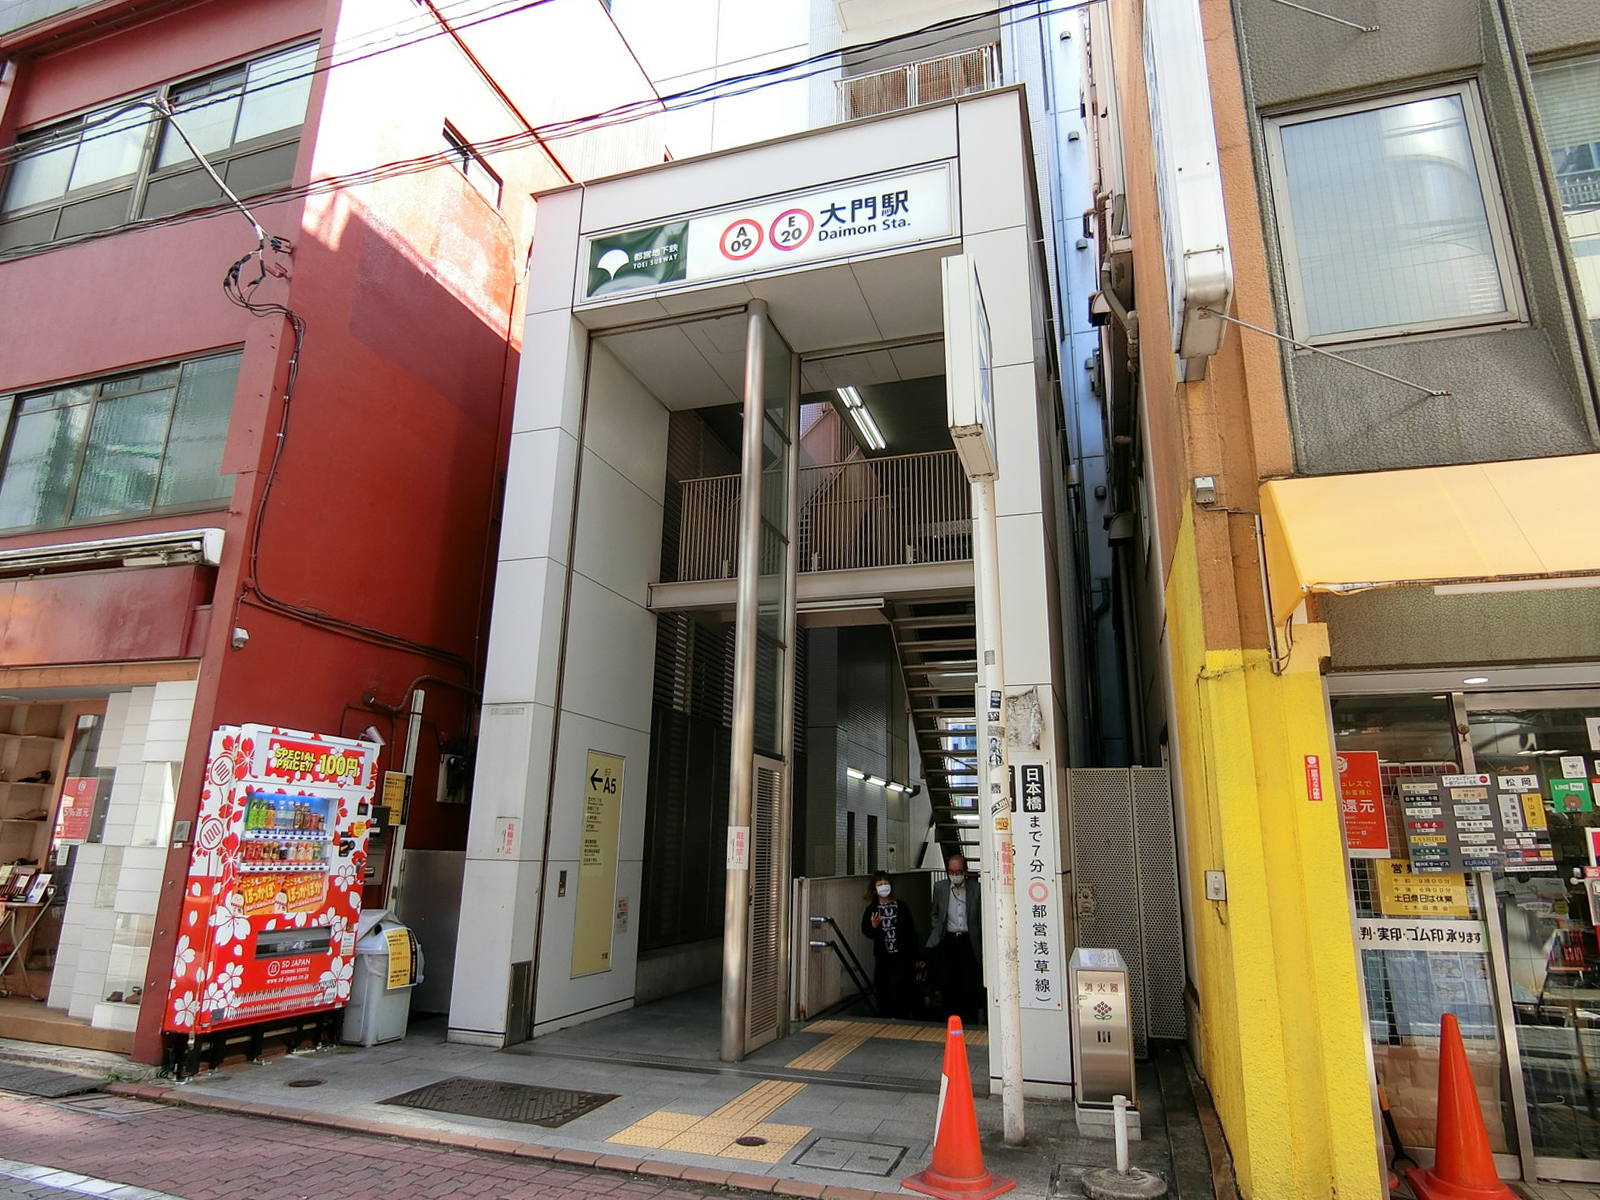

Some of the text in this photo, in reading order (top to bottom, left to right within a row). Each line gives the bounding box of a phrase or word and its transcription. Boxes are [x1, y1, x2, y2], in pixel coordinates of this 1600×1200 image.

[820, 190, 909, 228] 大門駅
[787, 216, 796, 228] E
[818, 217, 911, 242] Daimon Sta.
[736, 226, 748, 238] A
[781, 227, 802, 244] 20
[634, 243, 679, 262] 都営地下鉄
[730, 238, 753, 252] 09
[633, 253, 678, 270] TOEI SUBWAY
[275, 748, 316, 762] SPECIAL
[320, 754, 358, 778] 100円
[603, 777, 617, 794] A5
[1505, 777, 1532, 787] 松岡
[203, 823, 221, 845] 100
[1001, 841, 1012, 886] 駐輪禁止
[1394, 893, 1453, 903] 土日祭日は休業
[281, 957, 311, 969] SD JAPAN
[1084, 982, 1119, 993] 消火器
